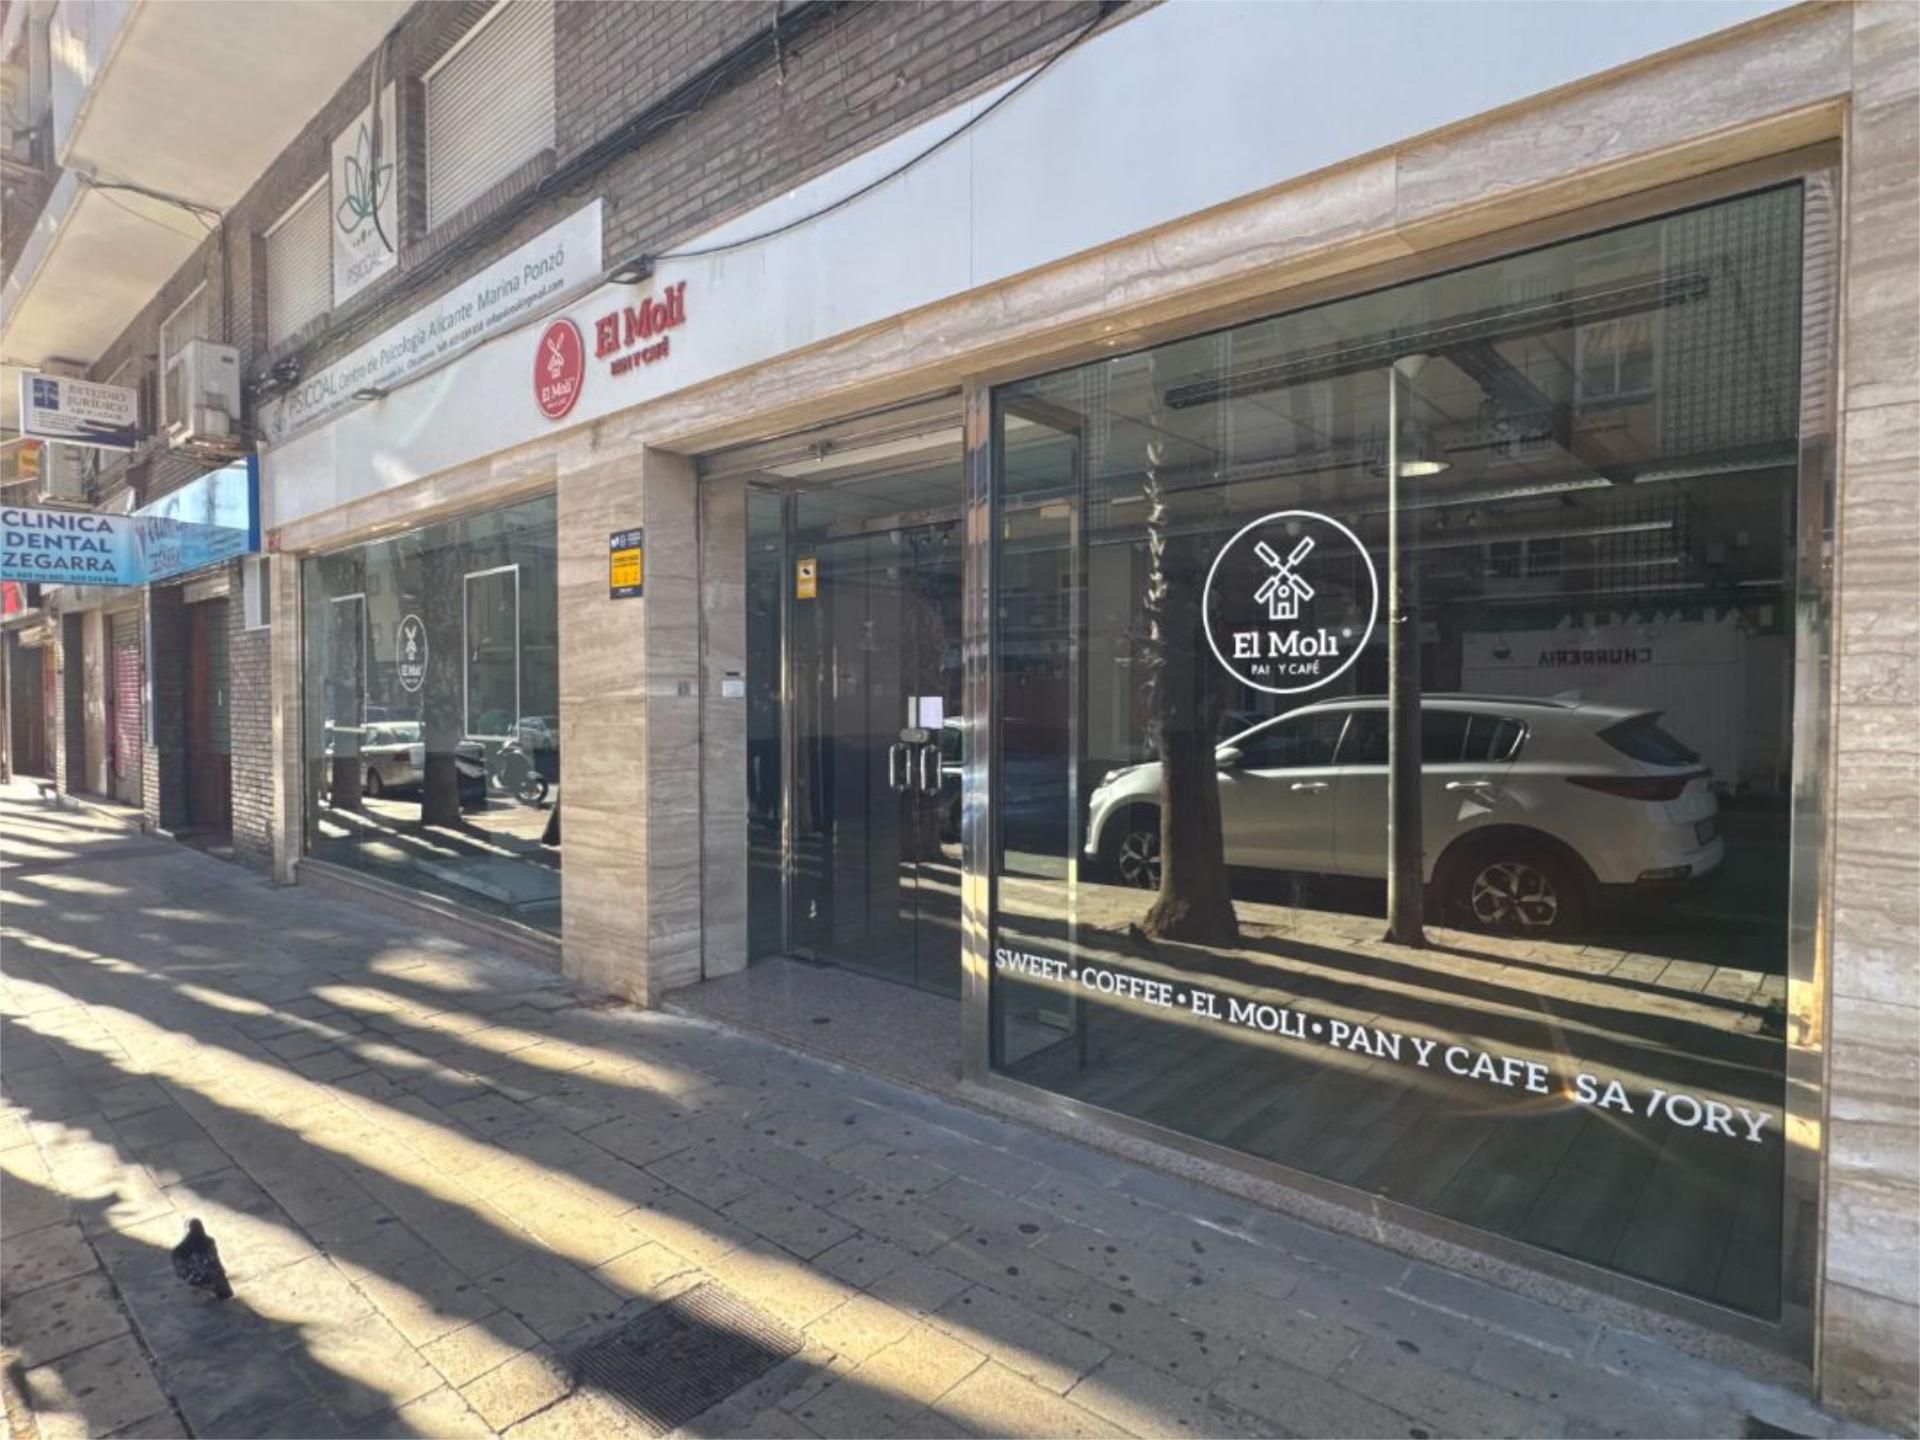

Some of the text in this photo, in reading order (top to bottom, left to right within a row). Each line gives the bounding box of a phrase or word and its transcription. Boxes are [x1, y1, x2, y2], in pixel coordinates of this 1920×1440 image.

[429, 303, 473, 340] Alicante
[478, 276, 519, 311] Marina
[524, 243, 564, 285] Ponzó
[595, 311, 620, 358] El
[1, 510, 114, 533] CLINICA
[6, 531, 113, 553] DENTAL
[2, 552, 116, 572] ZEGARRA
[1232, 631, 1261, 658] El
[1278, 663, 1286, 675] Y
[1288, 660, 1320, 675] CAFÉ
[995, 948, 1067, 982] SWEET
[1082, 966, 1172, 1008] COFFEE
[1190, 989, 1221, 1021] EL
[1228, 997, 1306, 1039] MOLI
[1329, 1020, 1402, 1061] PAN
[1410, 1038, 1438, 1068] Y
[1444, 1046, 1549, 1095] CAFE
